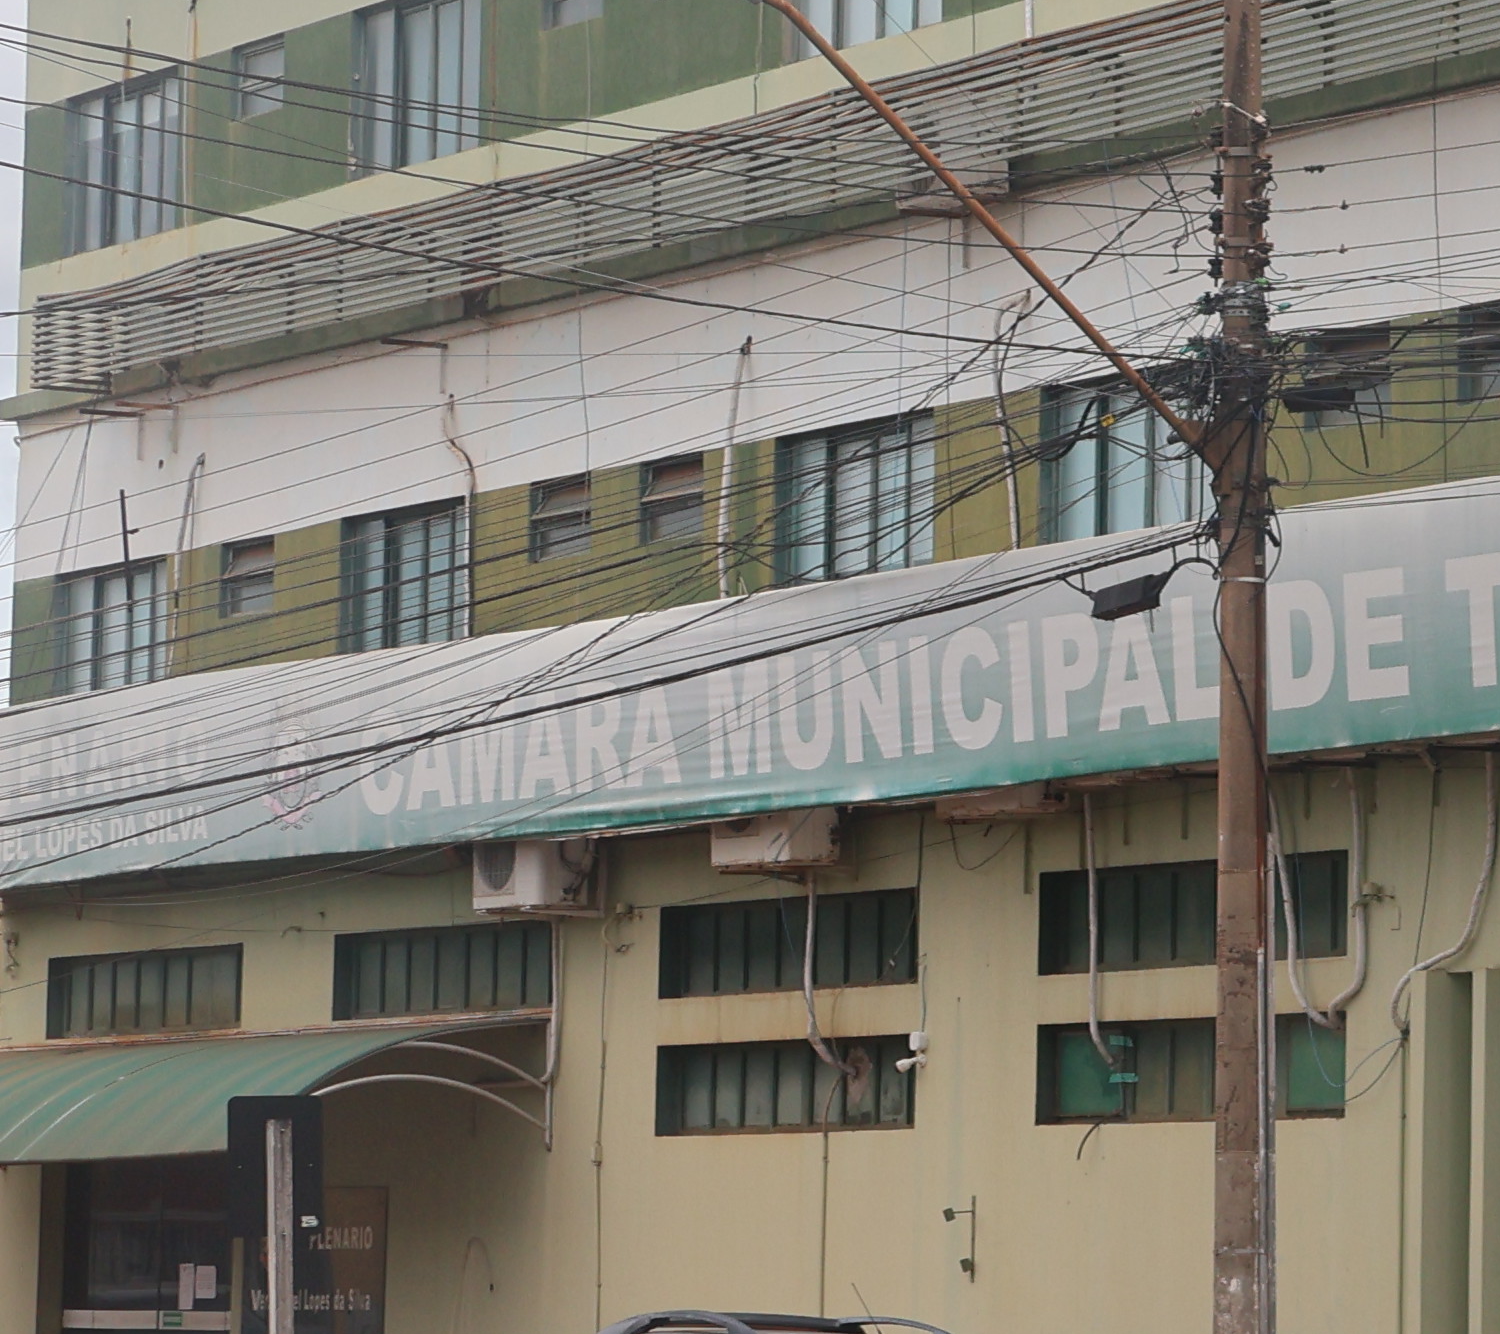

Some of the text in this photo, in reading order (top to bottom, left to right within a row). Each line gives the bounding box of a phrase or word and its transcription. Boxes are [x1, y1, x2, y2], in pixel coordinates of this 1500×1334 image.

[707, 591, 1222, 780] MUNICIPAL
[1268, 566, 1410, 712] DE
[35, 817, 104, 859] LOPES
[110, 817, 139, 849] DA
[145, 805, 209, 846] SILVA
[303, 1288, 330, 1313] Lopes
[334, 1288, 345, 1310] da
